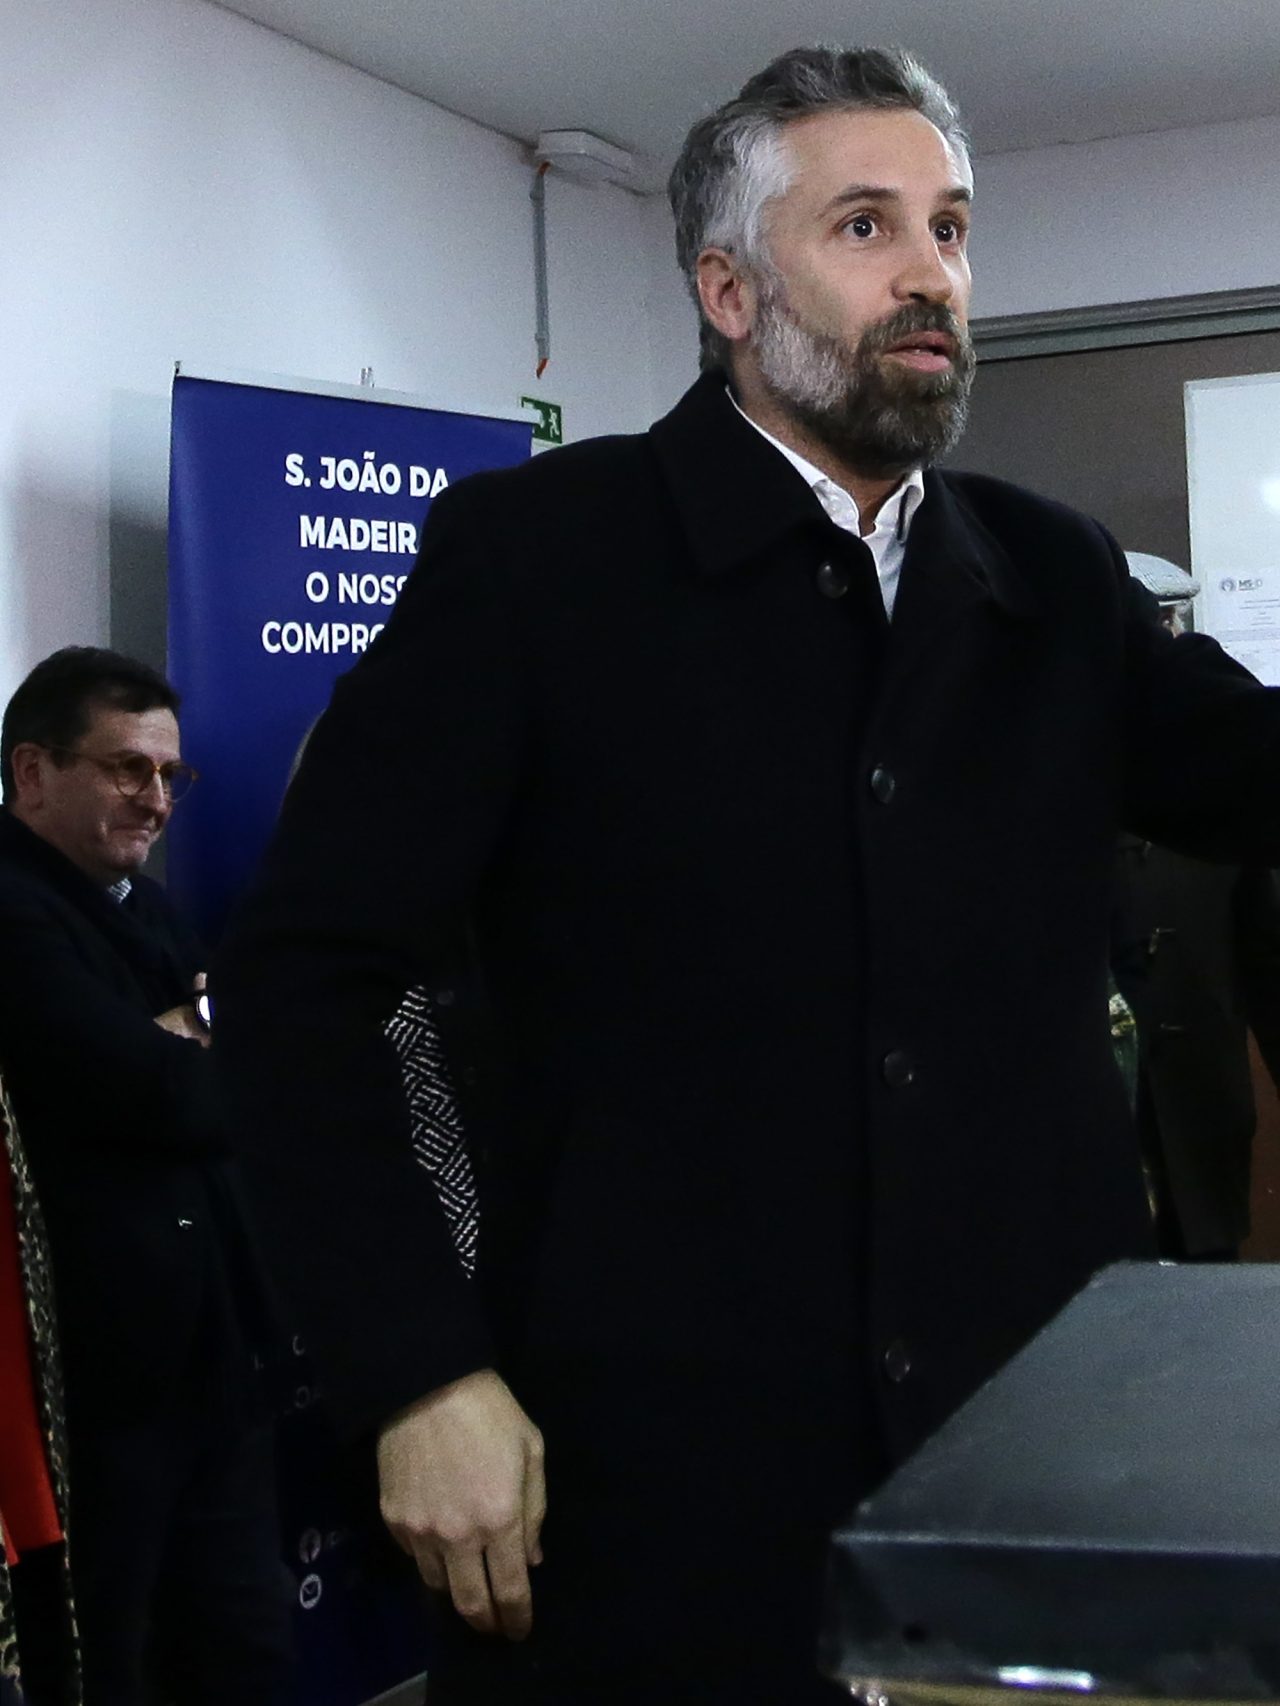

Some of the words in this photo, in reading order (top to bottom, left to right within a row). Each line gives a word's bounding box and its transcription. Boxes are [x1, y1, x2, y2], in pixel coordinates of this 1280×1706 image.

[285, 453, 311, 487] S.
[319, 451, 401, 495] JOÃO
[409, 465, 449, 498] DA
[299, 515, 418, 554] MADEIR
[305, 571, 329, 603] O
